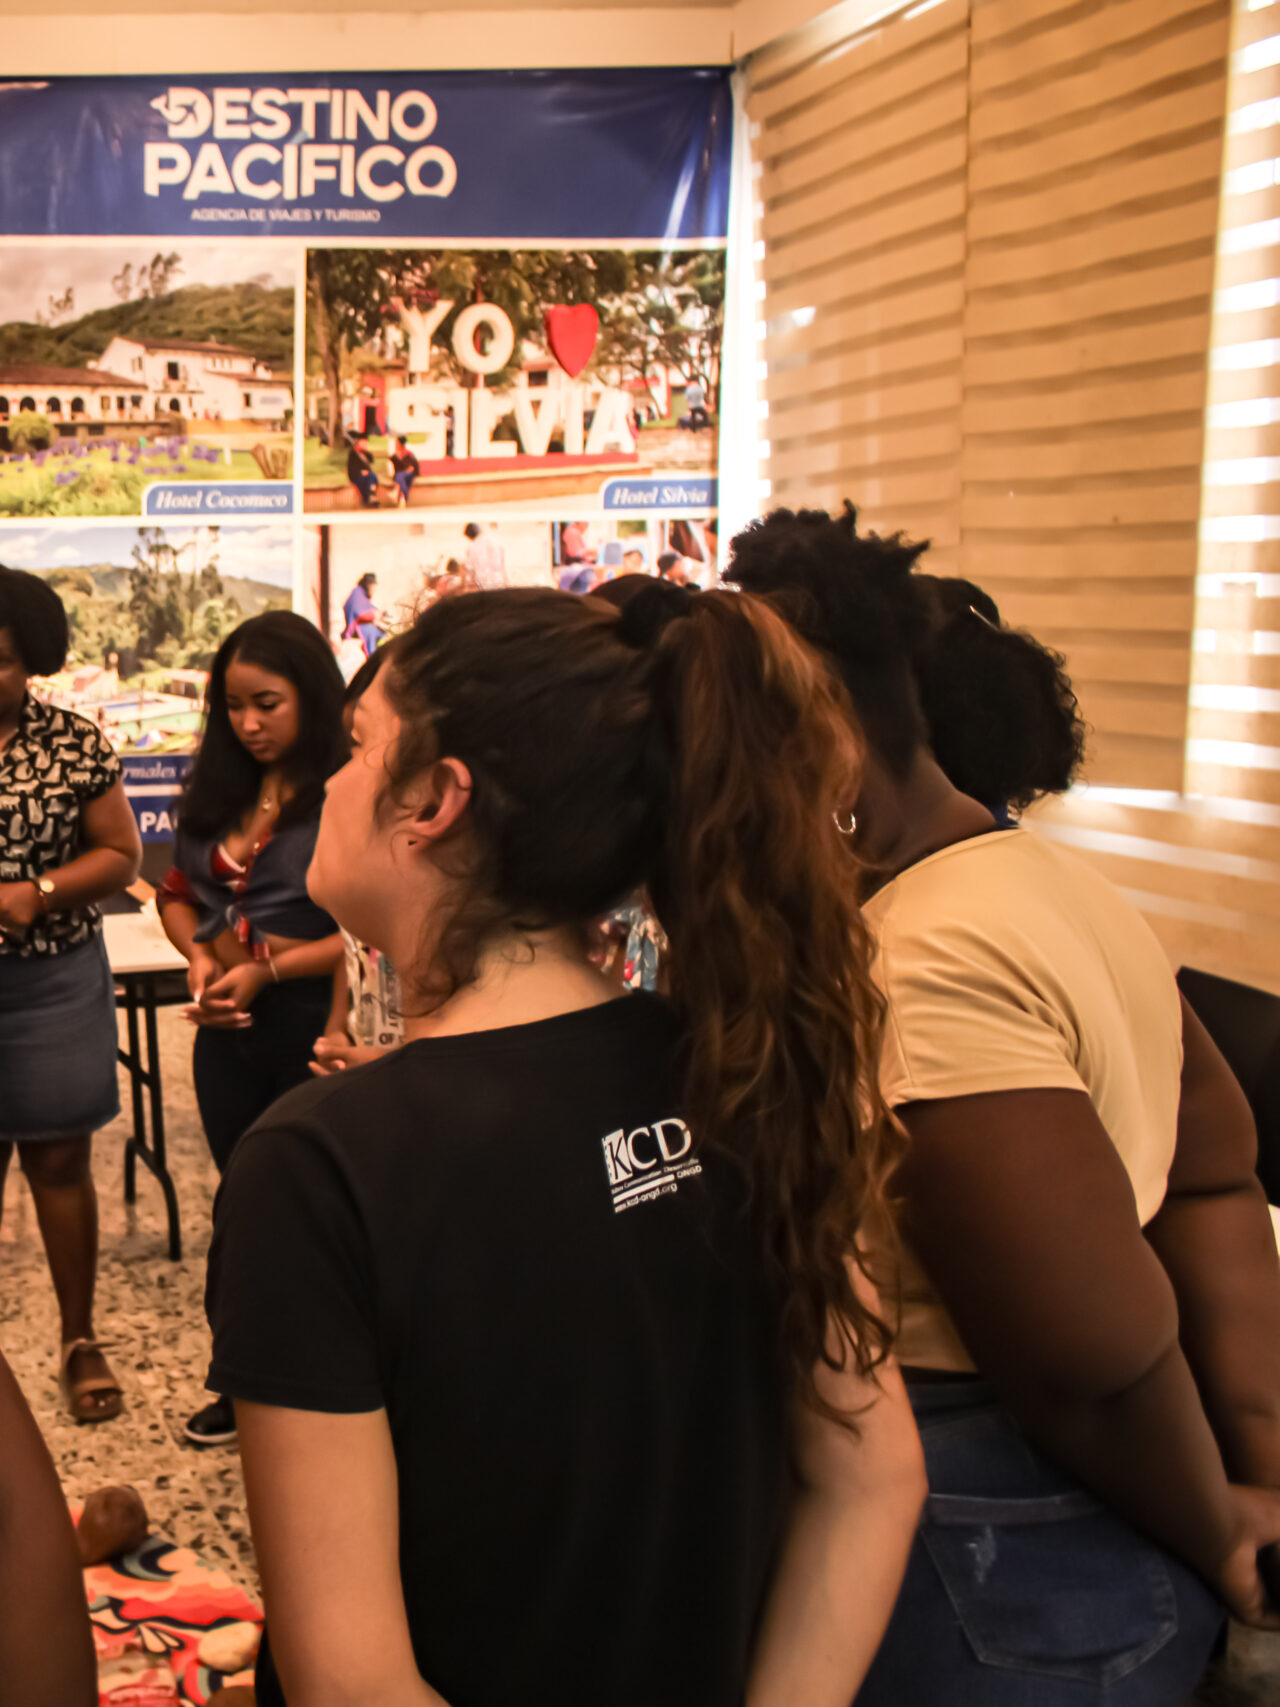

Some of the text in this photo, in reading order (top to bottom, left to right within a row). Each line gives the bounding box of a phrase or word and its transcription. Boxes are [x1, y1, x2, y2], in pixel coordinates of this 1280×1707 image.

[150, 86, 438, 142] DESTINO
[191, 208, 247, 222] AGENCIA
[248, 208, 266, 222] DE
[268, 208, 312, 222] VIAJES
[324, 208, 381, 223] TURISMO
[390, 297, 515, 374] YO
[389, 387, 637, 460] SILVIA
[156, 490, 203, 509] Hotel
[613, 485, 709, 505] Hotel Silvia
[122, 761, 177, 779] rmales
[140, 811, 178, 833] PA
[602, 1118, 692, 1186] KCD
[676, 1165, 702, 1178] ONGD
